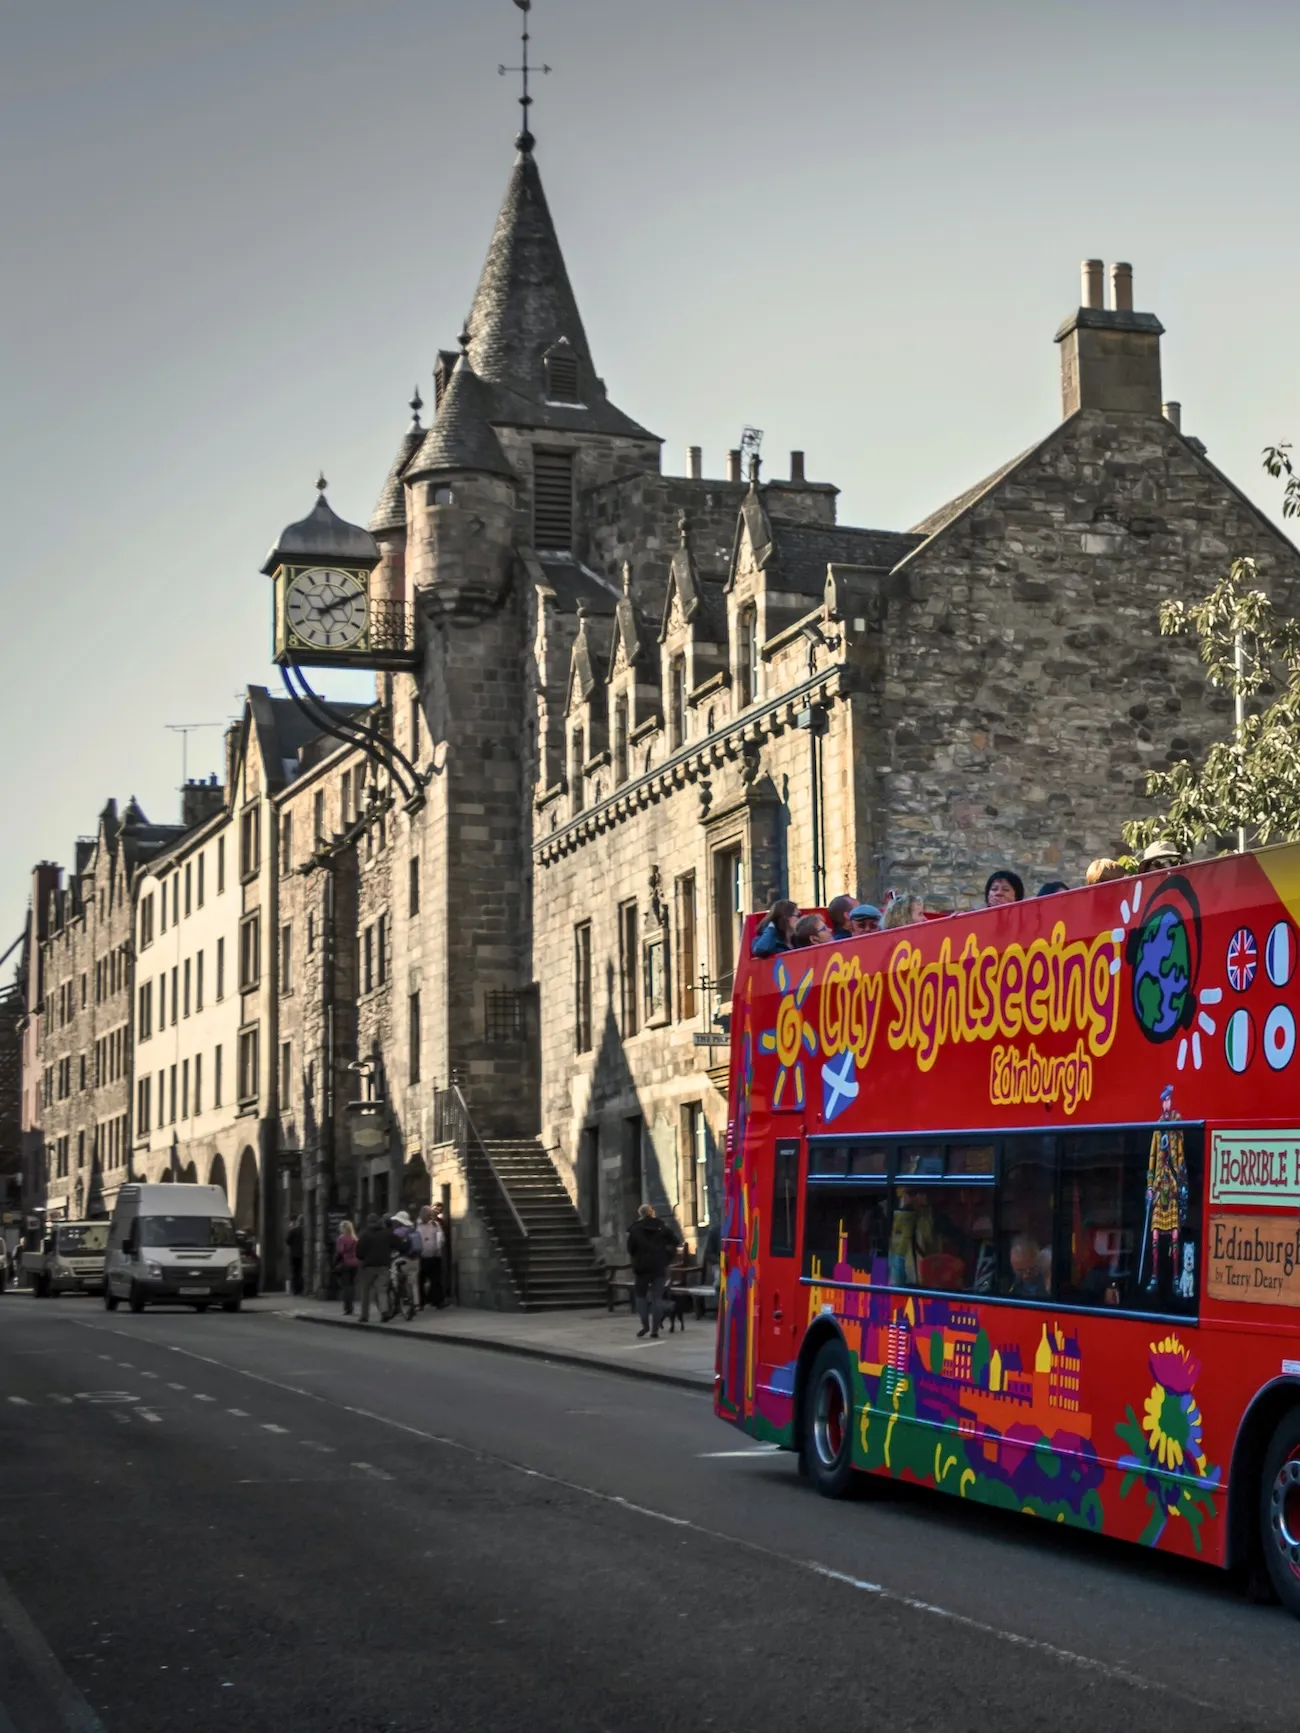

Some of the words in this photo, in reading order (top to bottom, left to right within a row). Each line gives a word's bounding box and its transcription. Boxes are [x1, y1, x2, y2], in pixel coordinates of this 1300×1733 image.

[819, 952, 883, 1069] City
[887, 921, 1122, 1073] Sightseeing
[990, 1039, 1093, 1115] Edinburgh
[1215, 1267, 1224, 1282] by
[1225, 1265, 1251, 1293] Terry
[1253, 1268, 1284, 1297] Deary
